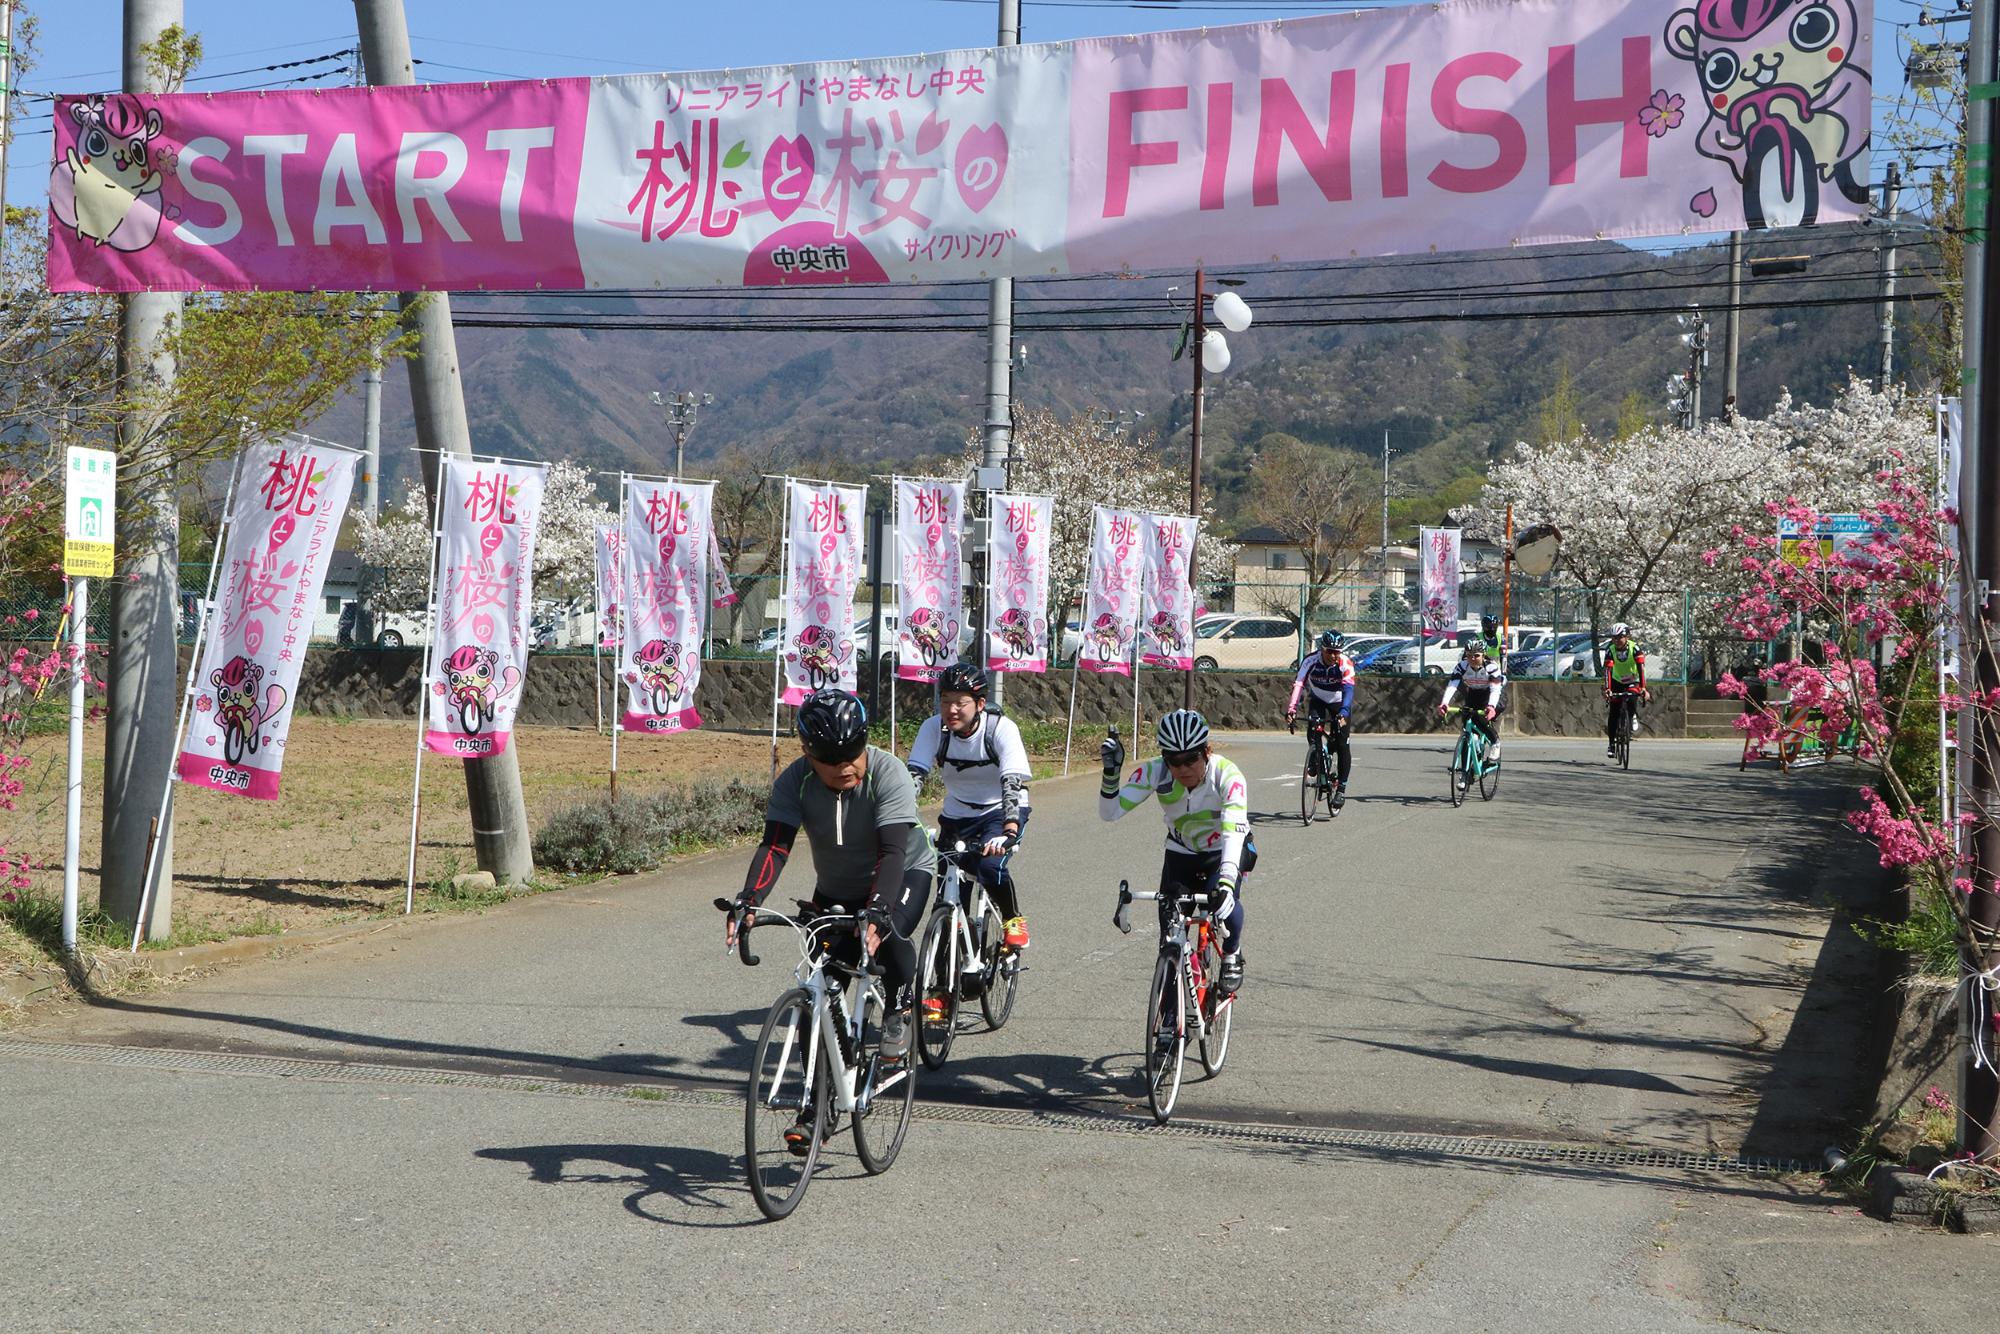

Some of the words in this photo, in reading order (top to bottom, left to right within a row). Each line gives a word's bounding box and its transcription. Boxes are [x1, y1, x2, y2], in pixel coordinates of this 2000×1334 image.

[665, 65, 986, 114] リニアライドやまなし中央
[1102, 35, 1652, 219] FINISH
[171, 126, 555, 247] START
[627, 107, 1003, 243] 桃と桜の
[773, 245, 849, 273] 中央市
[904, 228, 1018, 263] サイクリング
[236, 449, 318, 648] 桃と桜の
[278, 498, 333, 663] リニアライドやまなし中央
[454, 470, 517, 637] 桃と桜の
[511, 508, 533, 649] リニアライドやまなし中央
[219, 559, 242, 637] サイクリング
[441, 565, 455, 634] サイクリング
[454, 738, 493, 753] 中央市
[646, 718, 681, 731] 中央市
[207, 765, 251, 791] 中央市
